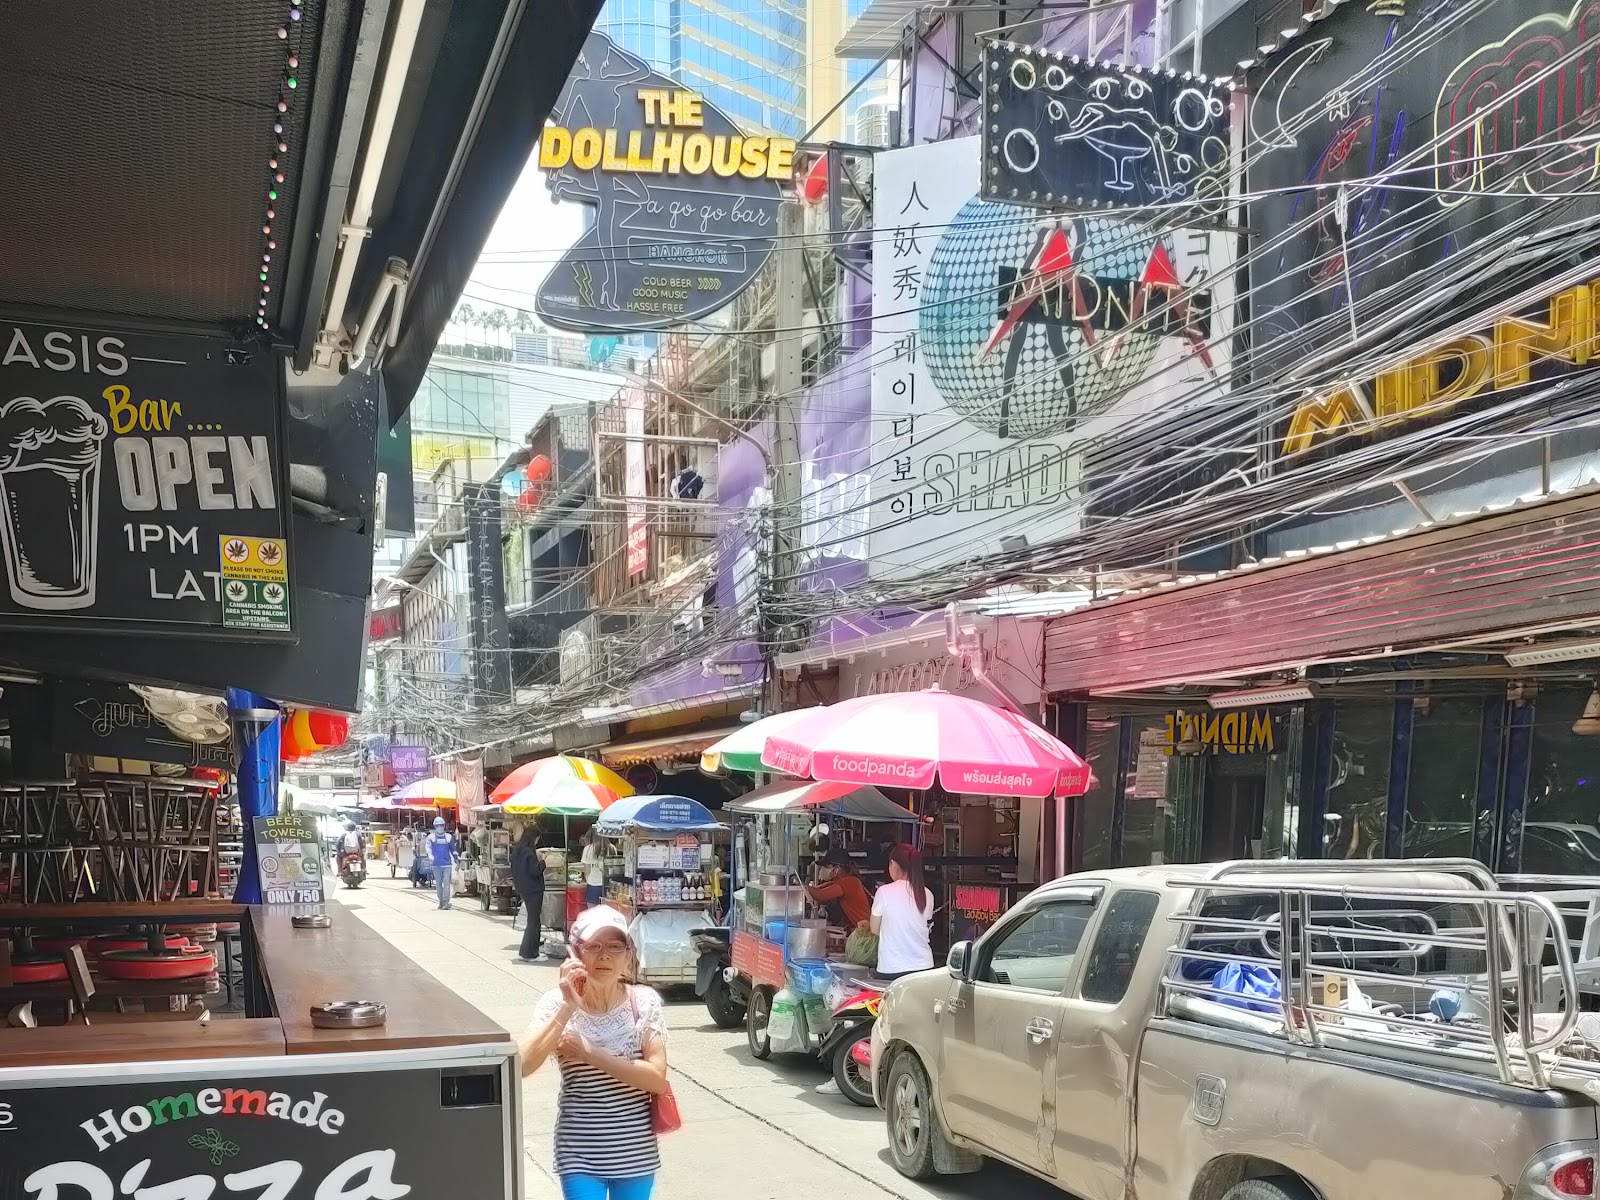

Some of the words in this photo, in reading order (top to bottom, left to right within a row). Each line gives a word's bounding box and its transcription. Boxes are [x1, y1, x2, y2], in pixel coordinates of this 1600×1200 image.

[637, 89, 704, 126] THE
[539, 126, 797, 180] DOLLHOUSE
[646, 200, 663, 215] a
[669, 205, 696, 229] go
[700, 206, 727, 233] go
[731, 197, 770, 227] bar
[892, 180, 930, 302] 人妖秀
[648, 244, 728, 265] BANGKOK
[633, 288, 659, 298] GOOD
[660, 289, 688, 300] MUSIC
[642, 277, 668, 288] COLD
[670, 278, 692, 288] BEER
[626, 302, 659, 312] HASSLE
[661, 303, 684, 313] FREE
[113, 435, 276, 511] OPEN
[124, 523, 199, 554] 1PM
[854, 656, 953, 698] LADYBOY
[956, 643, 1009, 691] BR
[832, 755, 915, 778] foodpanda
[963, 769, 1033, 789] พร้อมส่งสุดใจ
[261, 828, 312, 839] TOWERS
[266, 817, 302, 827] BEER
[267, 890, 296, 904] ONLY
[297, 890, 320, 903] 750
[955, 886, 1000, 913] SHADOW
[964, 909, 988, 923] Ladyboy
[79, 1087, 346, 1152] Homemade
